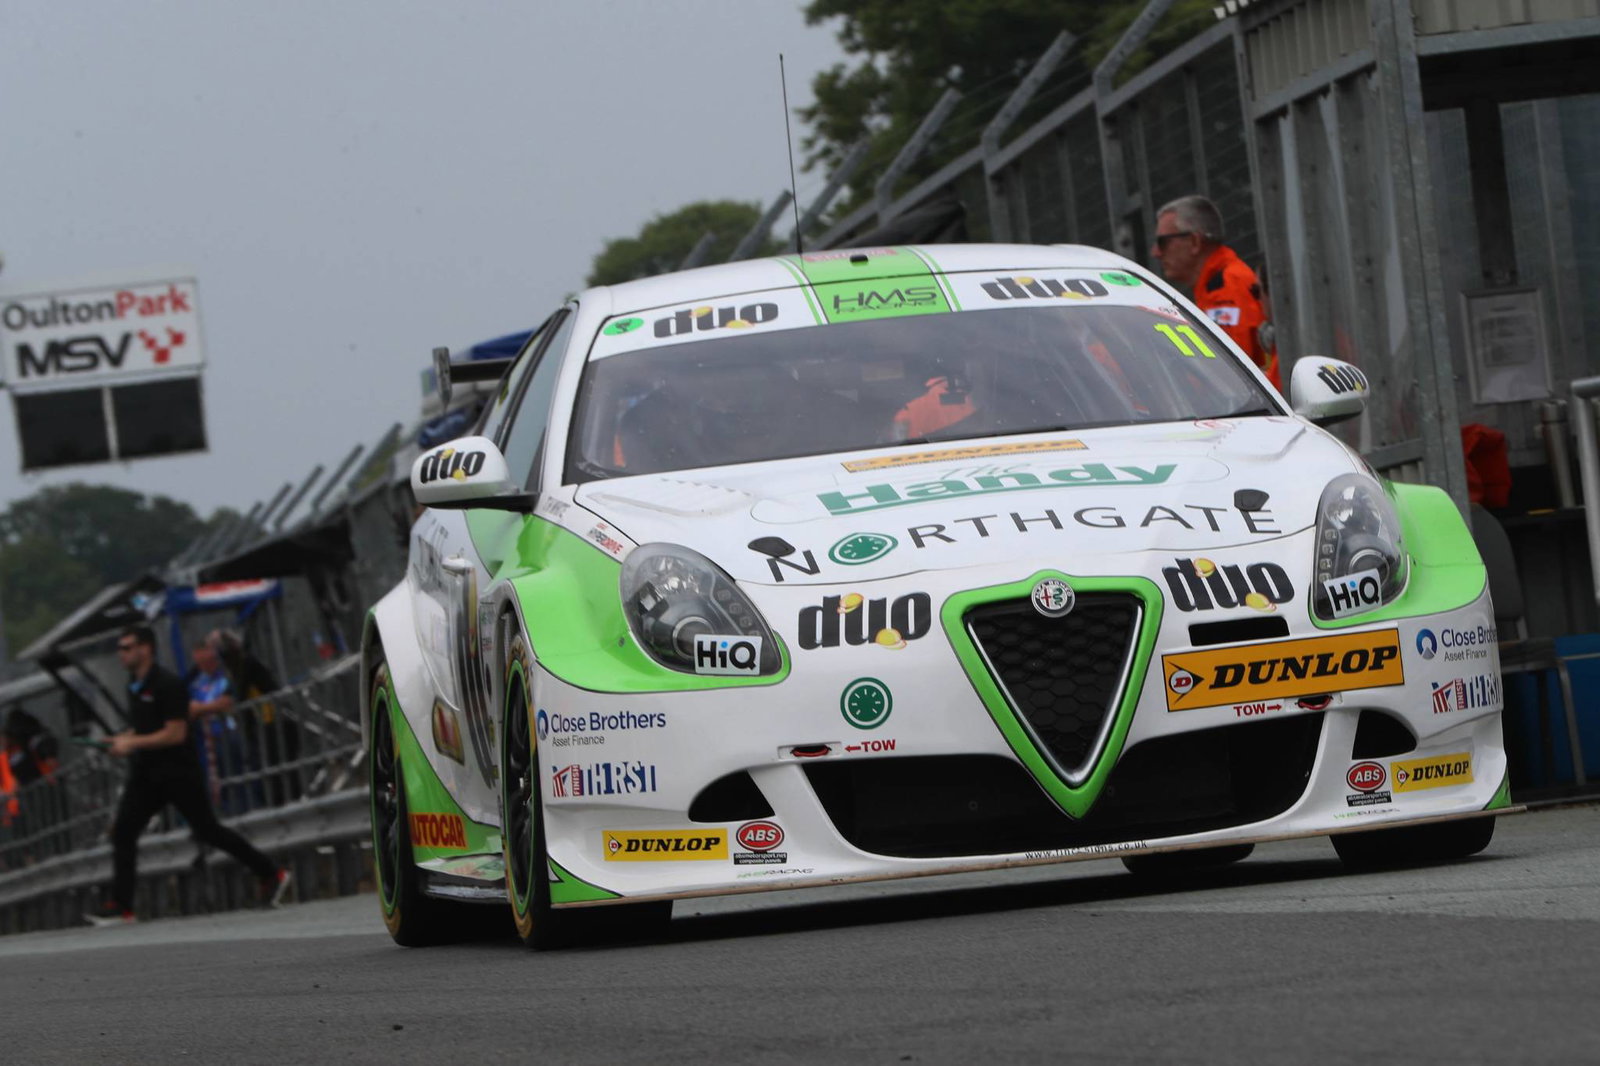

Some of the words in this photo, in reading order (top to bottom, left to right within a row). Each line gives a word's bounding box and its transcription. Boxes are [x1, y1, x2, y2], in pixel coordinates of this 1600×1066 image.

[834, 287, 937, 309] HMS
[980, 277, 1109, 300] duo
[653, 302, 779, 339] duo
[1153, 324, 1216, 358] 11
[16, 332, 132, 378] MSV
[1317, 364, 1367, 394] duo
[420, 448, 486, 484] duo
[816, 463, 1178, 513] Handy
[1162, 558, 1295, 612] duo
[1328, 576, 1379, 611] HiQ
[798, 592, 931, 650] duo
[1441, 628, 1476, 648] Close
[697, 641, 757, 670] HiQ
[1209, 646, 1398, 690] DUNLOP
[551, 714, 586, 733] Close
[590, 711, 666, 731] Brothers
[1234, 703, 1266, 717] TOW
[552, 736, 571, 747] Asset
[572, 735, 605, 746] Finance
[861, 739, 896, 752] TOW
[1354, 769, 1381, 784] ABS
[1412, 761, 1469, 781] DUNLOP
[625, 837, 720, 852] DUNLOP
[744, 829, 778, 842] ABS
